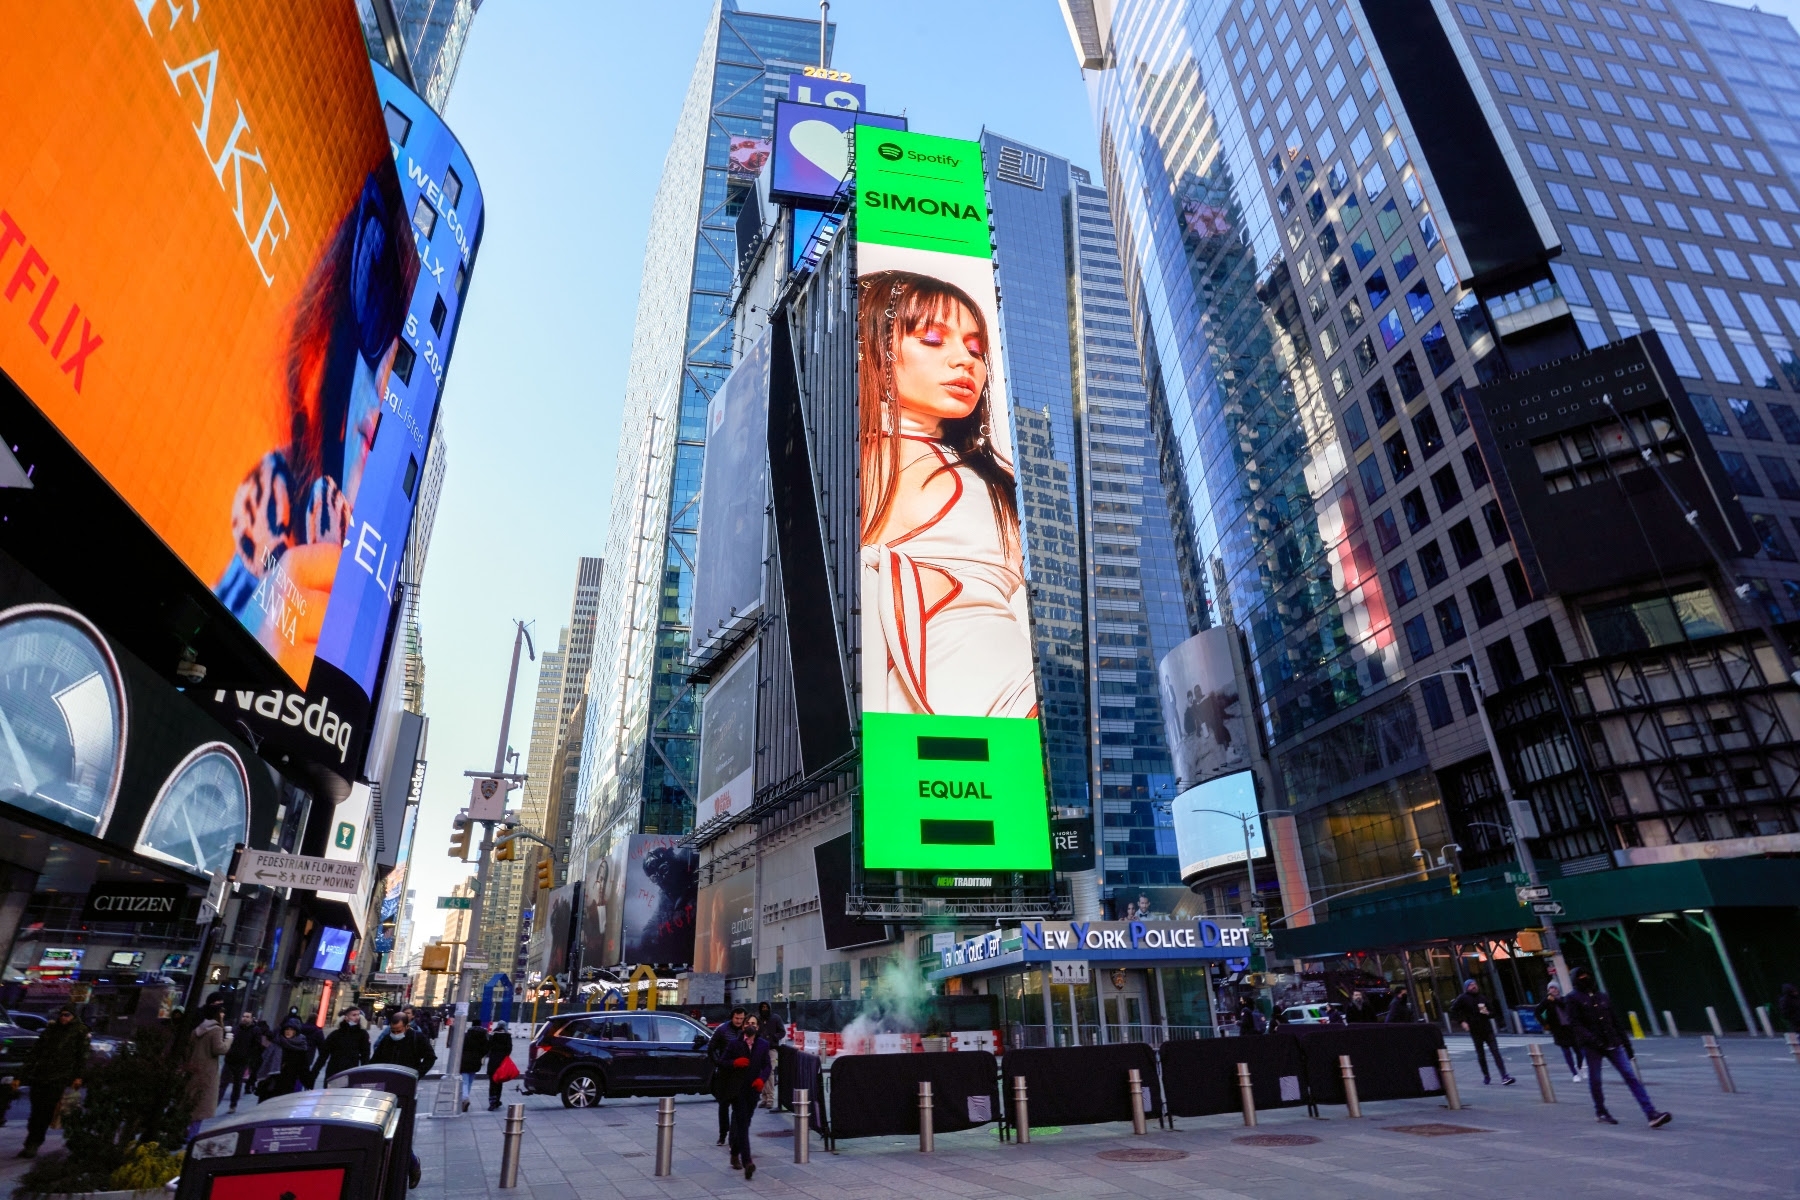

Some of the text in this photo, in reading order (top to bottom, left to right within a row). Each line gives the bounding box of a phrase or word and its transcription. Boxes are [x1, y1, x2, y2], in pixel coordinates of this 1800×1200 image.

[803, 65, 852, 83] 2022
[907, 150, 960, 168] Spotify
[408, 156, 472, 264] WELCOM
[865, 190, 982, 222] SIMONA
[0, 209, 104, 396] TFLIX
[260, 545, 307, 617] INVENTING
[252, 577, 298, 647] ANNA
[408, 762, 426, 802] Locker
[918, 780, 993, 800] EQUAL
[1055, 836, 1078, 850] RE
[256, 854, 358, 877] PEDESTRIAN FLOW ZONE
[1226, 851, 1248, 862] CHAS
[300, 874, 356, 890] KEEP MOVING
[93, 895, 176, 912] CITIZEN
[448, 898, 461, 908] 43
[638, 888, 655, 908] THE
[1021, 920, 1070, 950] NEW
[1070, 921, 1128, 950] YORK
[1128, 920, 1196, 950] POLICE
[1198, 920, 1250, 948] DEPT
[966, 940, 984, 964] POLICE
[984, 934, 1002, 960] DEPT
